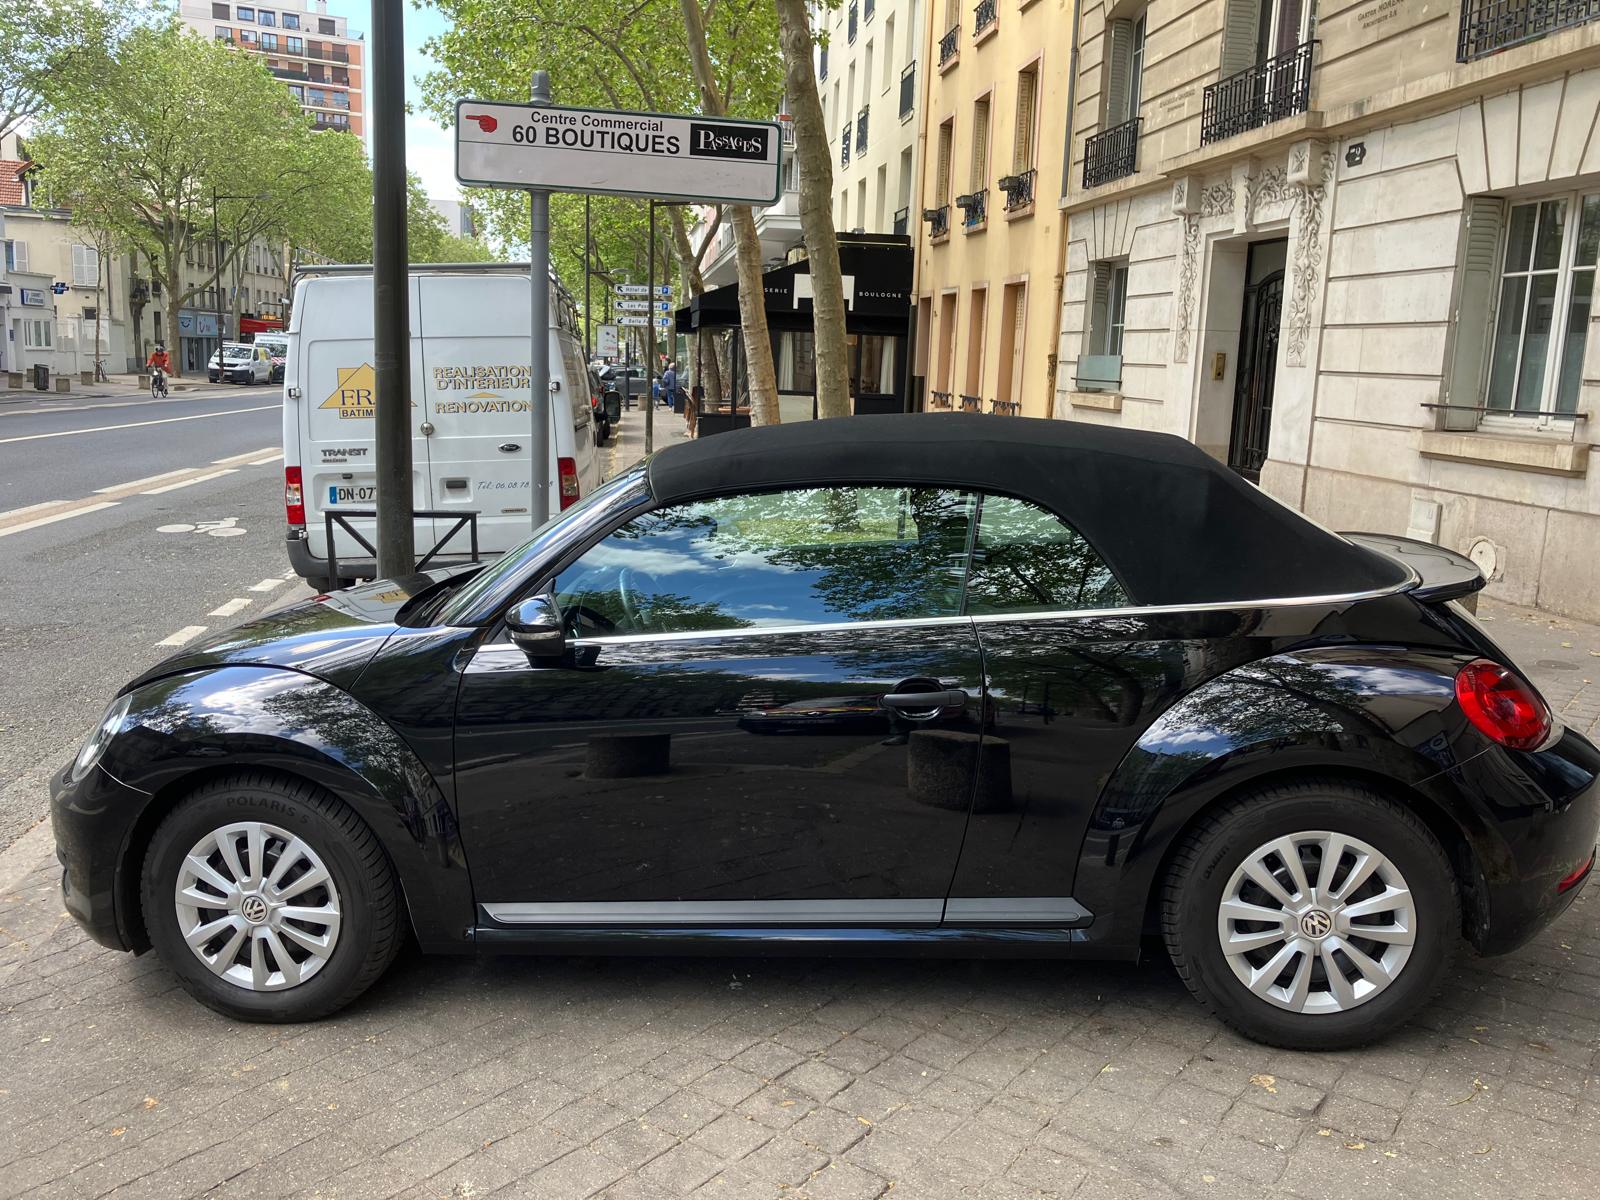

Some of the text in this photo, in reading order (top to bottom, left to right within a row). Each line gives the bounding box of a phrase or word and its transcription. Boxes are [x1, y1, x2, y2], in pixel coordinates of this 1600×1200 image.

[531, 111, 663, 132] Centre Commercial
[512, 124, 680, 155] 60 BOUTIQUES
[696, 129, 762, 153] PASSAGES
[433, 365, 532, 378] REALISATION
[437, 377, 530, 390] D'INTERIEUR
[342, 409, 374, 417] BATIM
[435, 400, 533, 414] RENOVATION
[321, 448, 368, 456] TRANSIT
[226, 796, 297, 817] POLARIS
